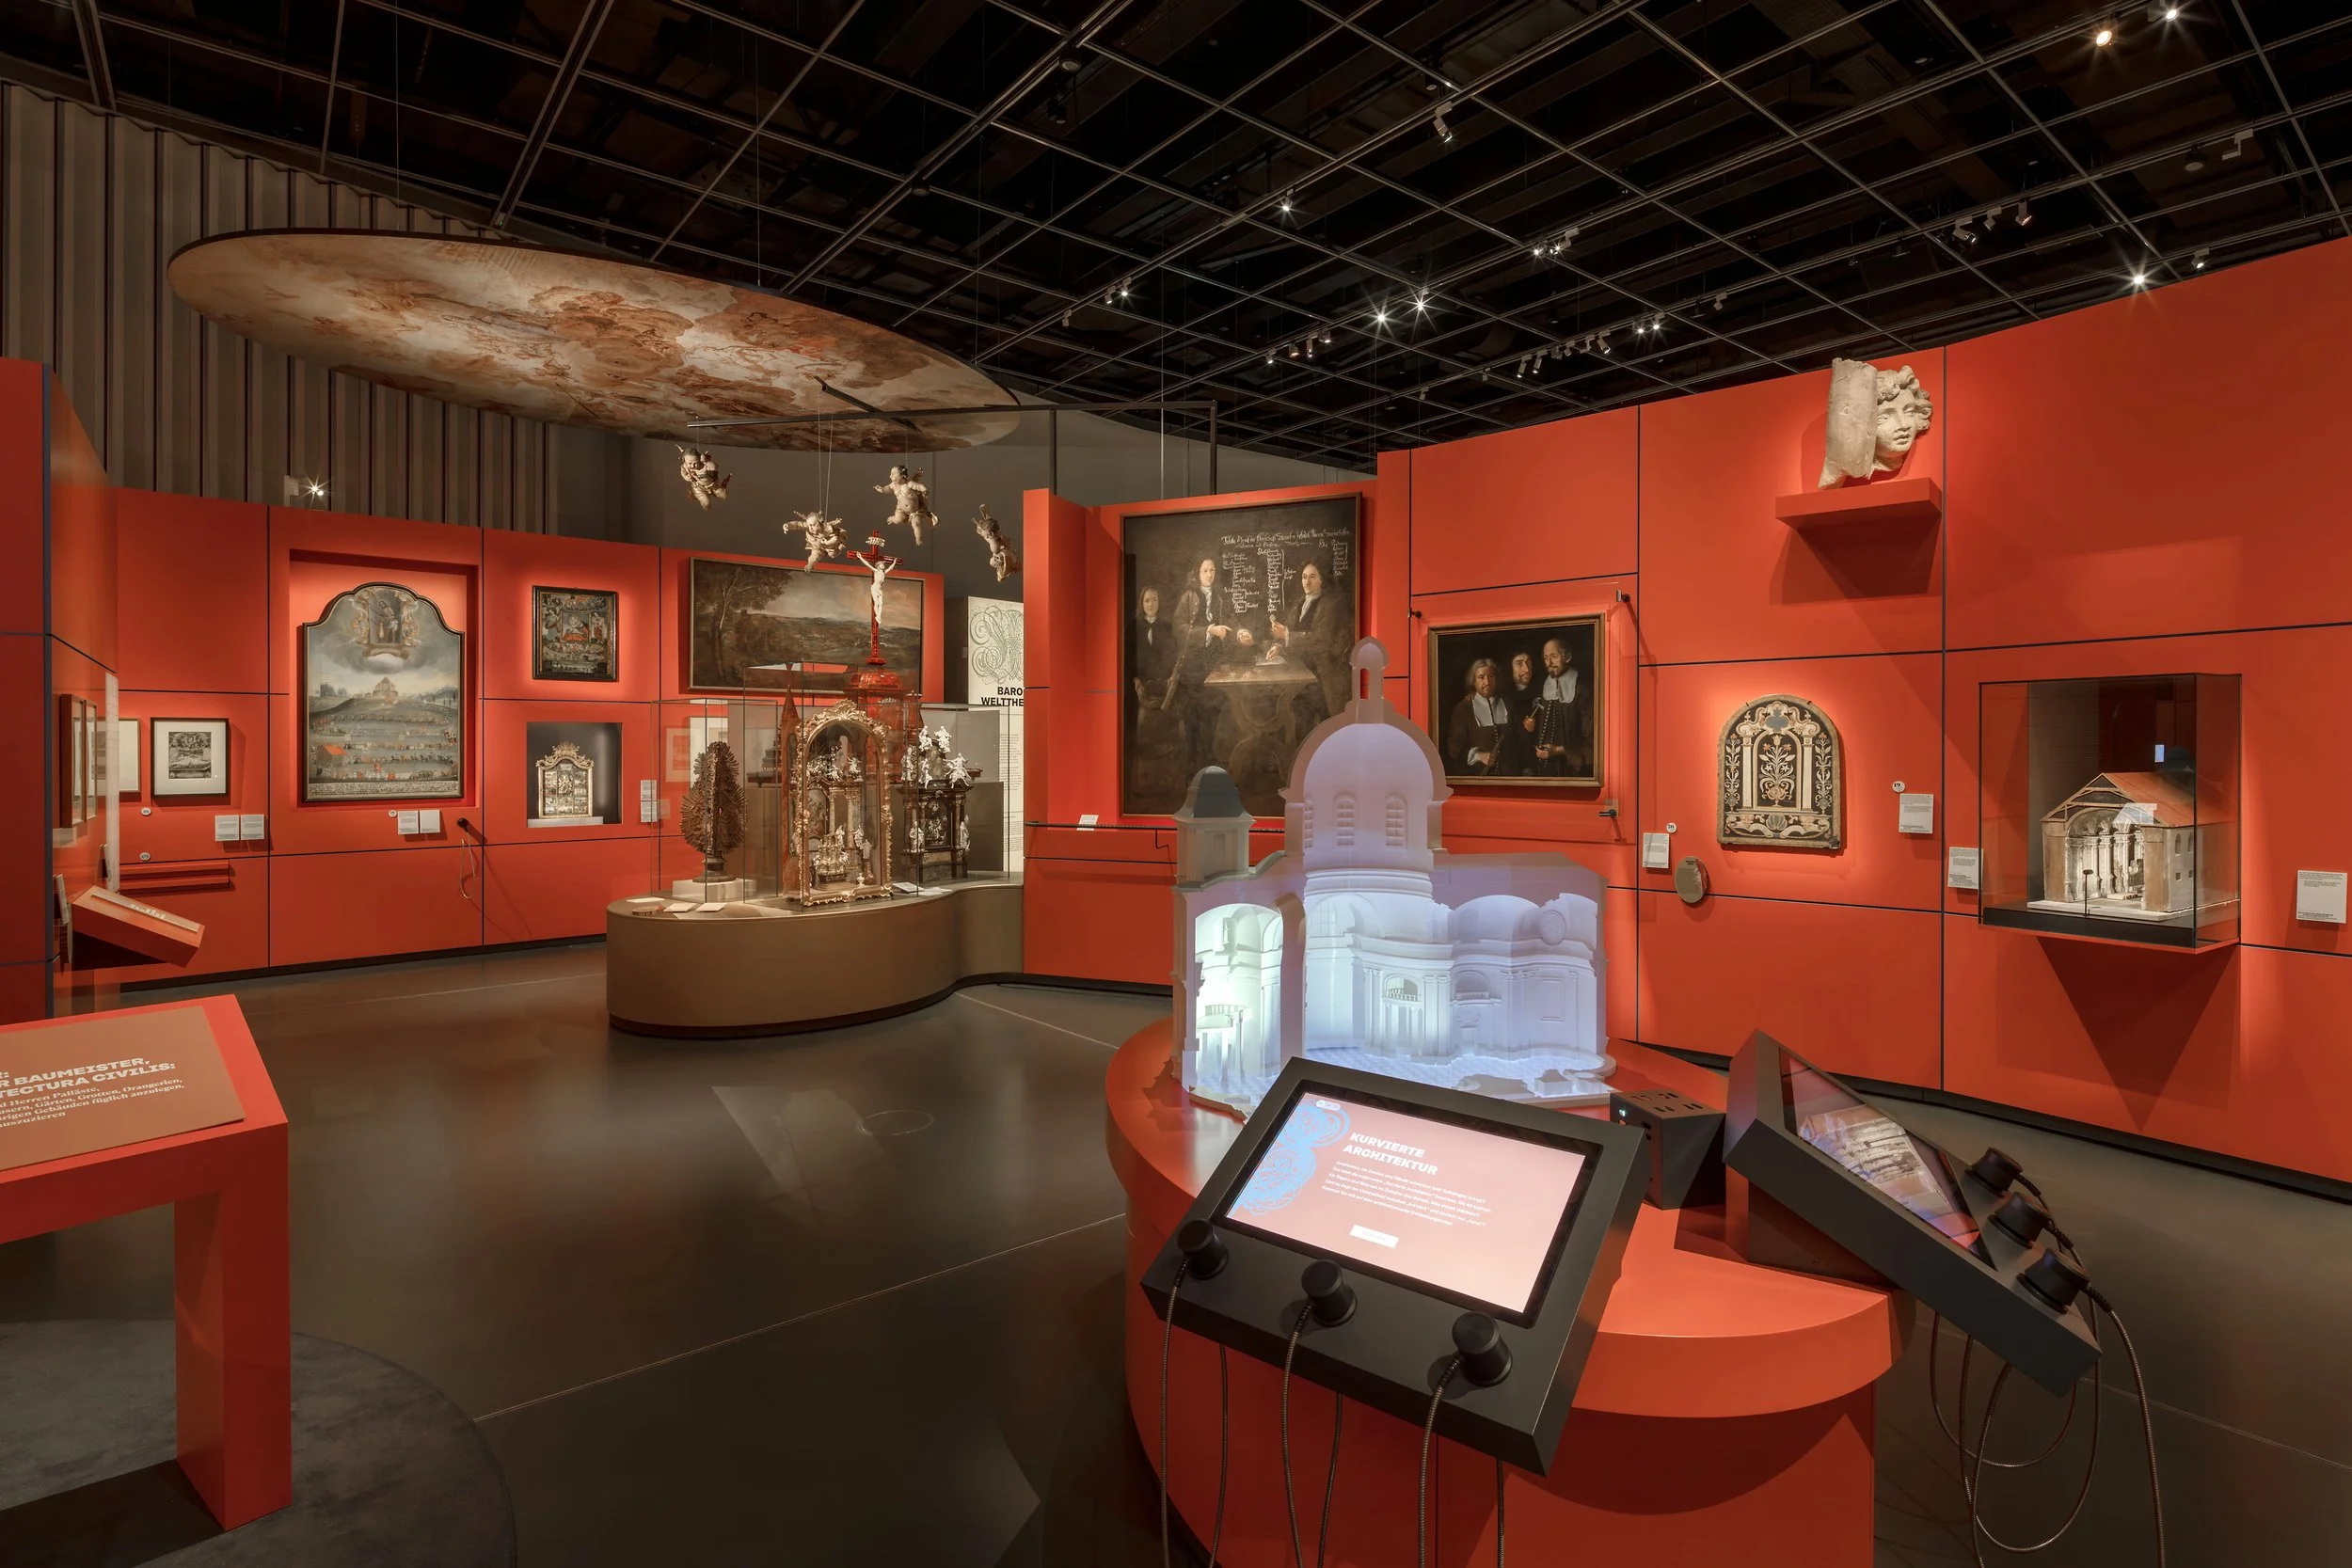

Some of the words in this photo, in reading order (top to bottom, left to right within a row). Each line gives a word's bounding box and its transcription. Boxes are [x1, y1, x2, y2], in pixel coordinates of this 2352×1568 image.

[980, 697, 1024, 706] WELTTHE
[997, 687, 1024, 696] BARO
[14, 1057, 151, 1085] BAUMEISTER,
[92, 1063, 176, 1083] CIVILIS:
[9, 1095, 51, 1107] Herren
[1350, 1132, 1427, 1159] KURVIERTE
[1343, 1144, 1438, 1176] ARCHITEKTUR
